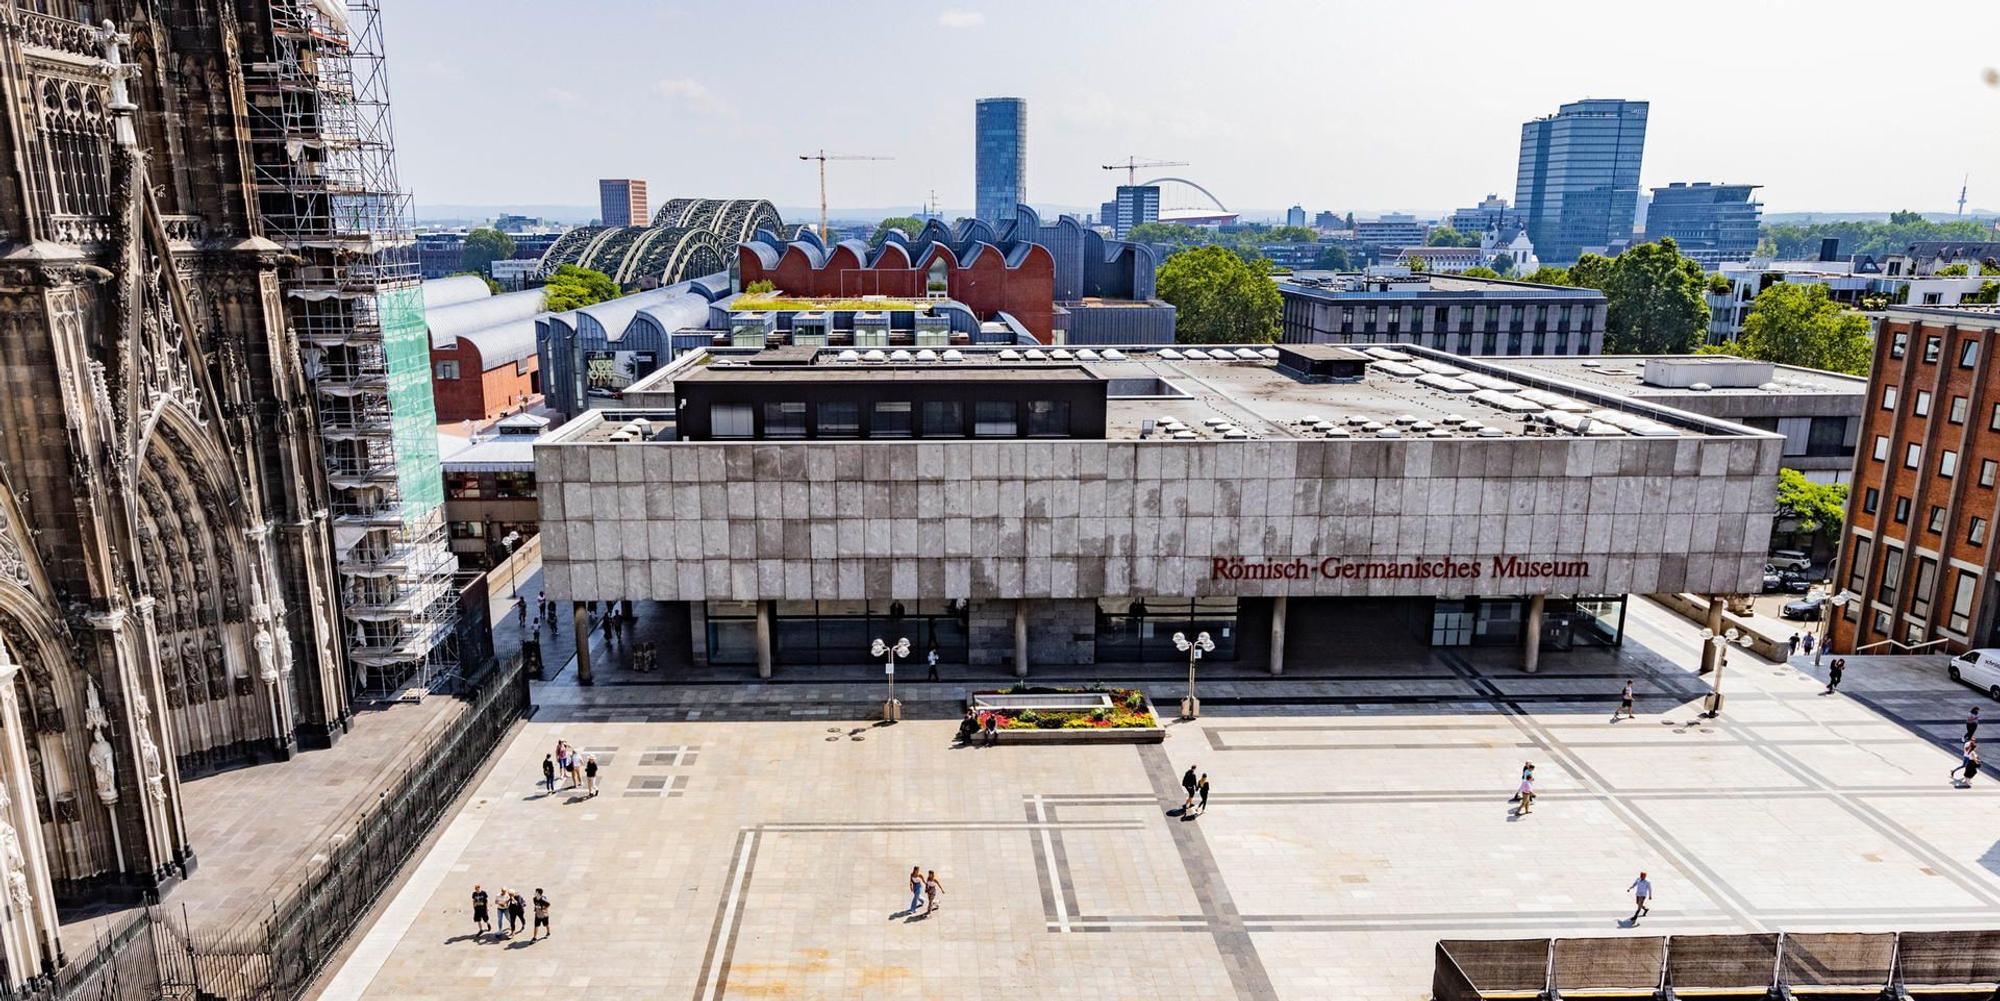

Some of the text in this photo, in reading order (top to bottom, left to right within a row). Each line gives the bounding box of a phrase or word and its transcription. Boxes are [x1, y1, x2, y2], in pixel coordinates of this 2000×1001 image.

[588, 360, 613, 370] VOR
[1211, 555, 1590, 580] Römisch-Germanisches Museum
